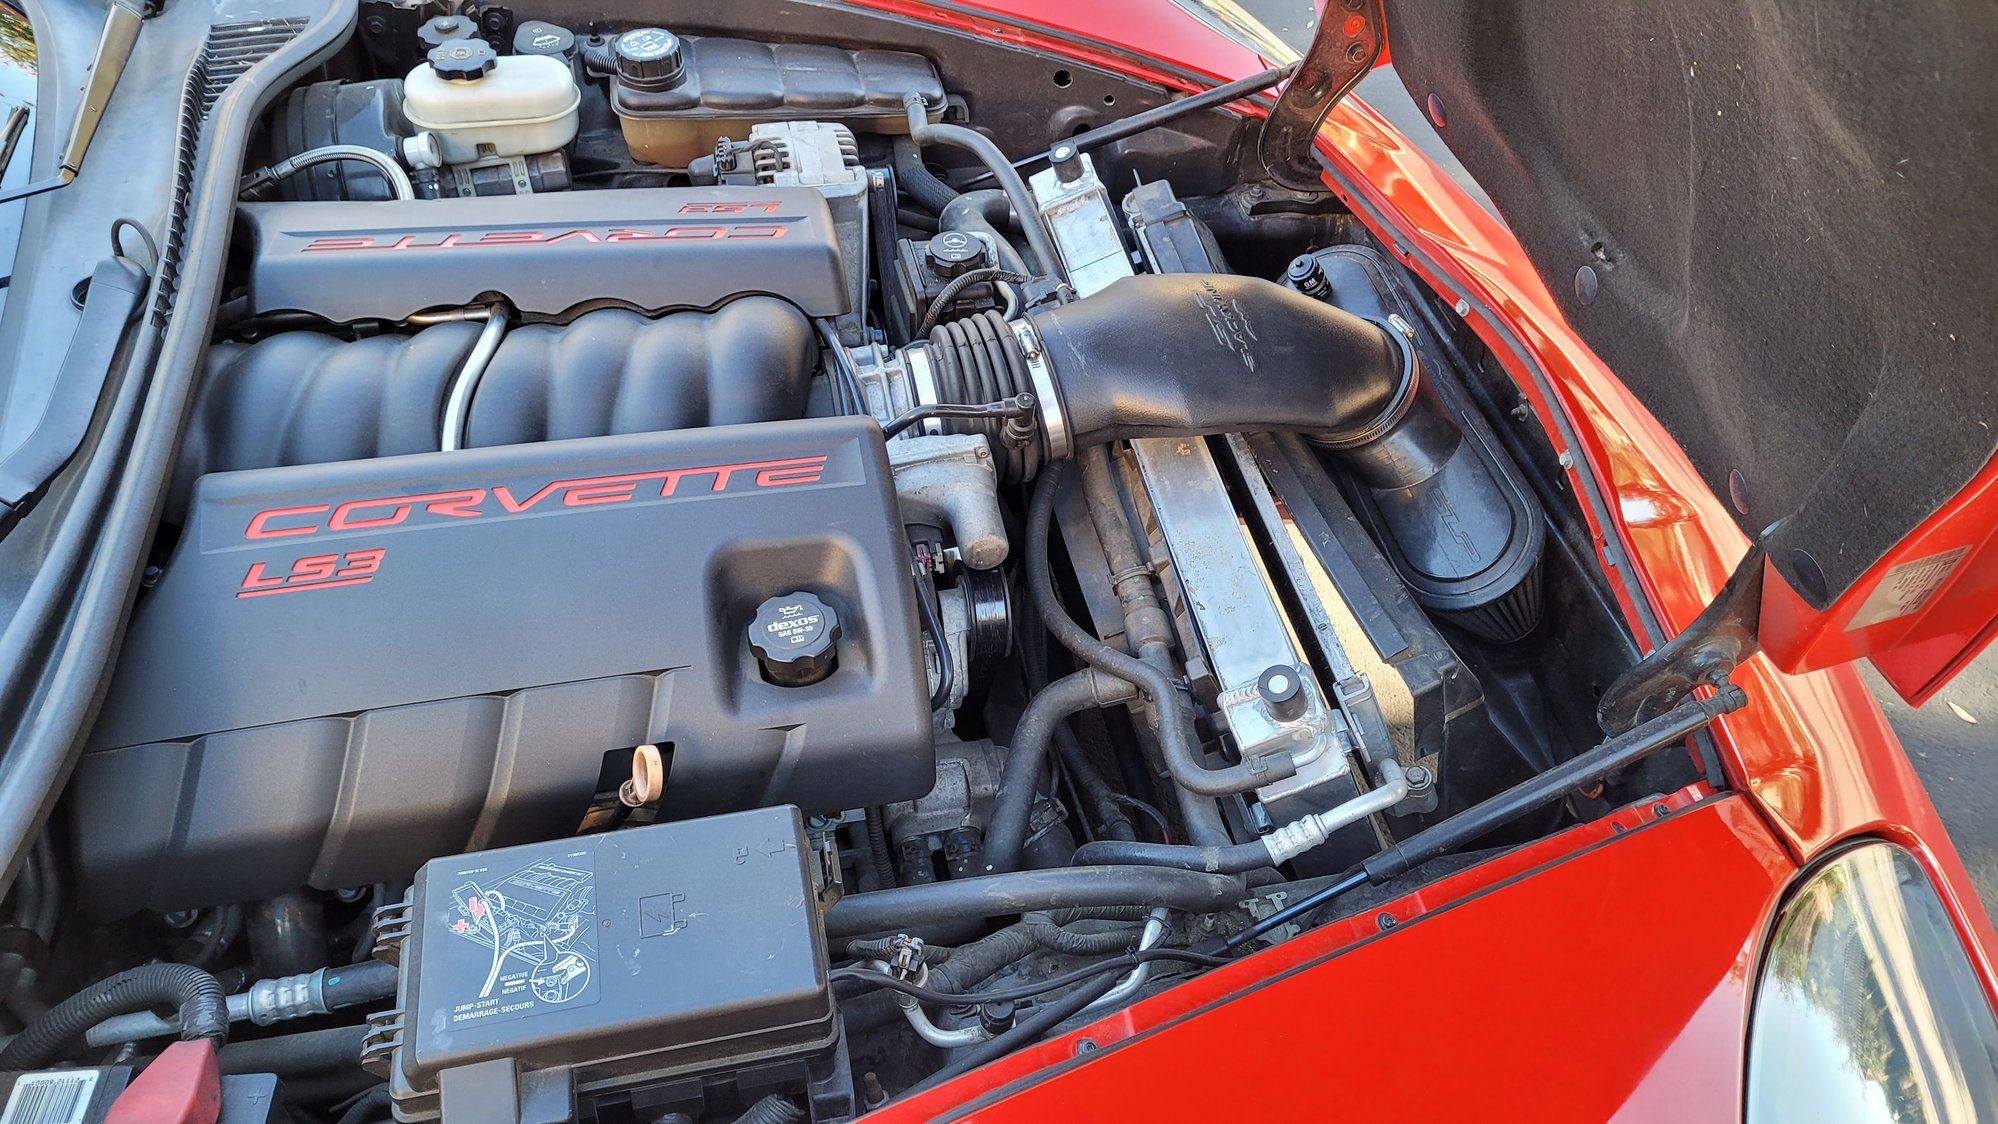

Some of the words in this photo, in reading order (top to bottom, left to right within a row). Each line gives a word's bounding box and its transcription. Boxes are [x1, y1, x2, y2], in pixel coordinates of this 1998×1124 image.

[677, 201, 783, 215] LS3
[301, 225, 789, 253] CORVETTE
[1304, 277, 1318, 290] GM
[244, 455, 828, 540] CORVETTE
[240, 548, 387, 588] LS3
[767, 614, 820, 632] dexos
[500, 971, 528, 982] NEGATIVE
[453, 998, 500, 1013] JUMP-START
